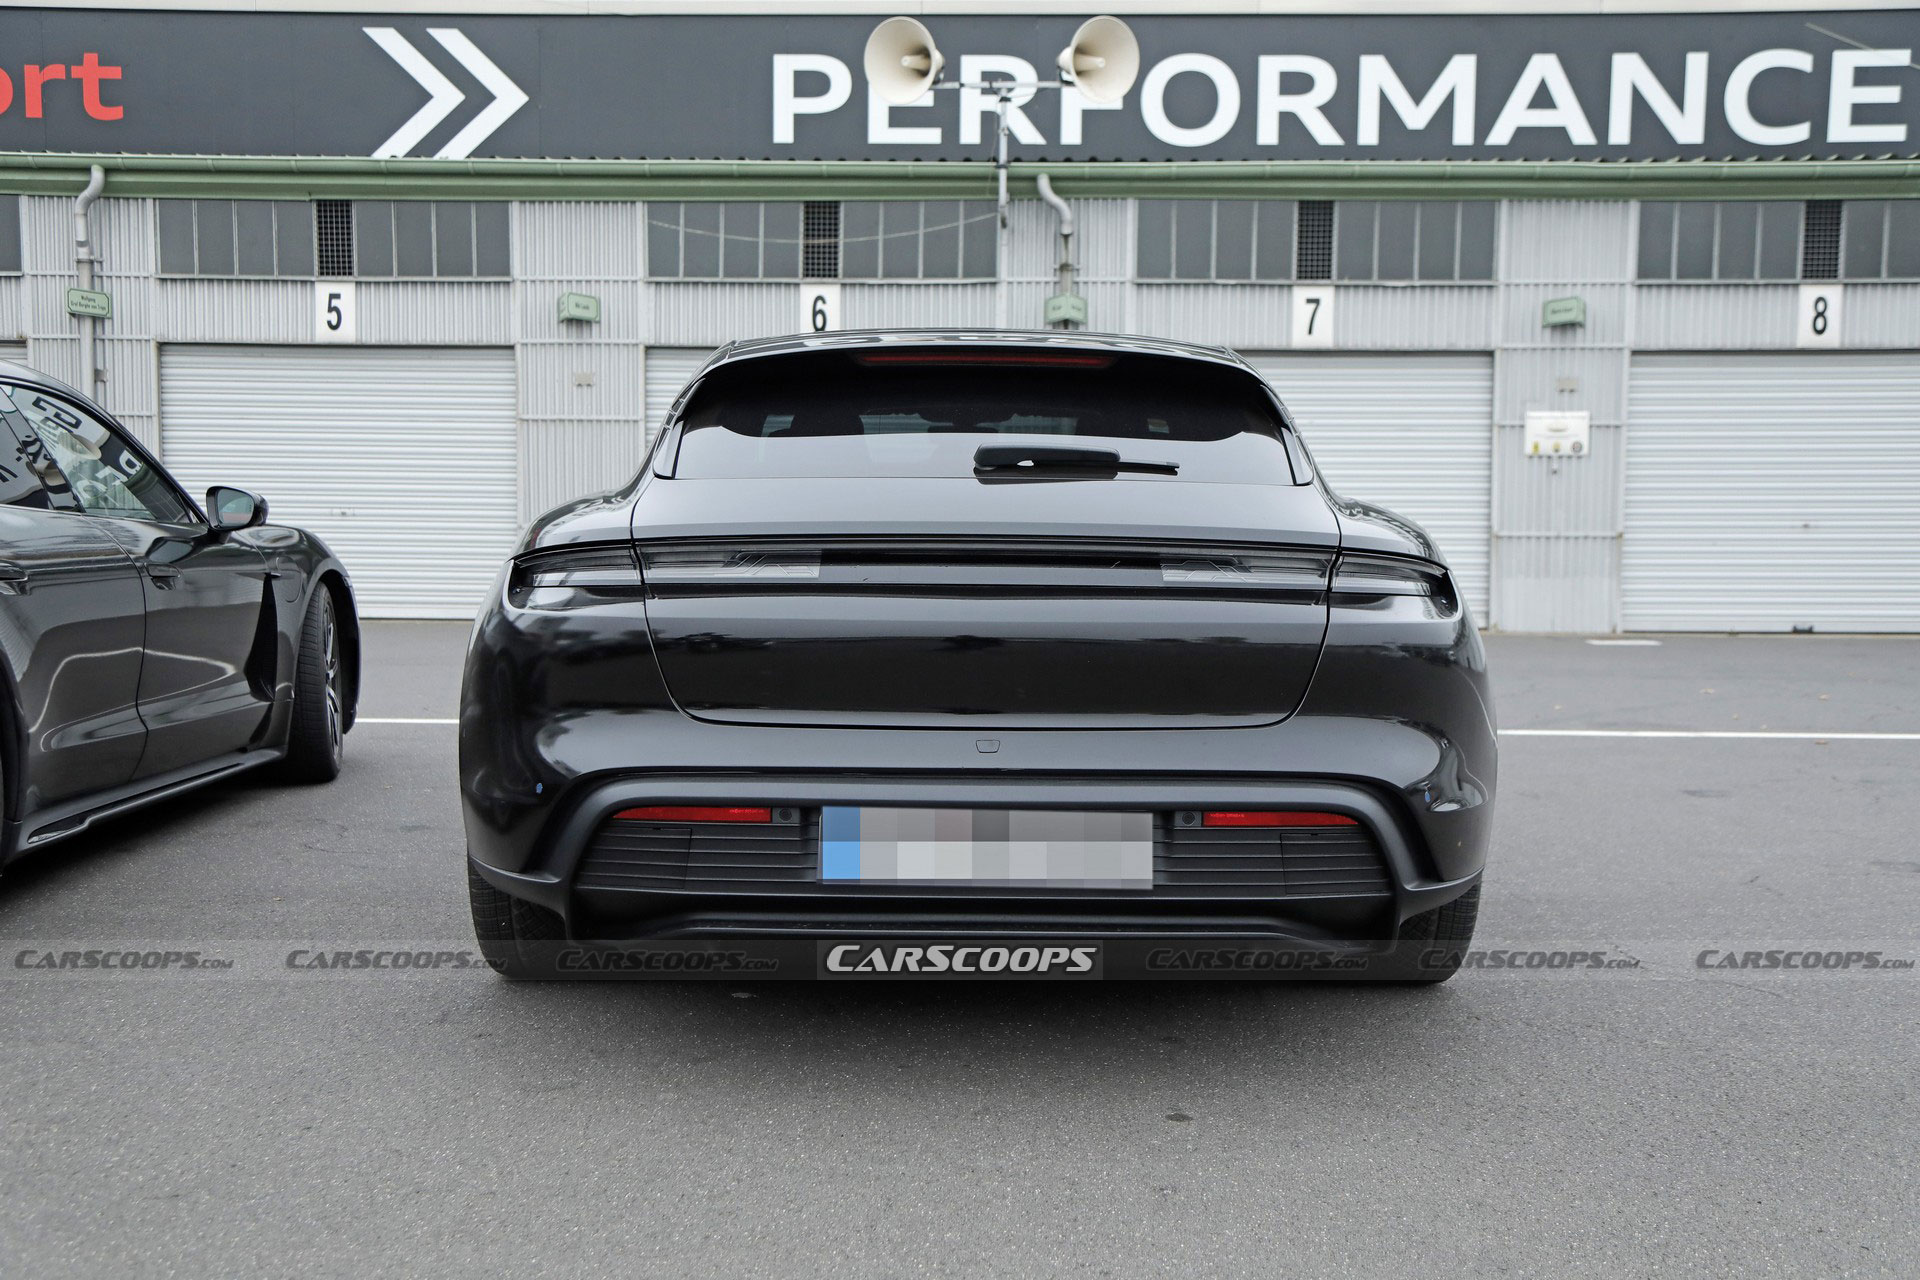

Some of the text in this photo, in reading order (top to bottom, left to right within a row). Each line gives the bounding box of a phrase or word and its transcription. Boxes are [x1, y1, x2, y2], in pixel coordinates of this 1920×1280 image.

[326, 293, 341, 331] 5
[812, 295, 827, 332] 6
[1305, 298, 1320, 335] 7
[1813, 297, 1827, 335] 8
